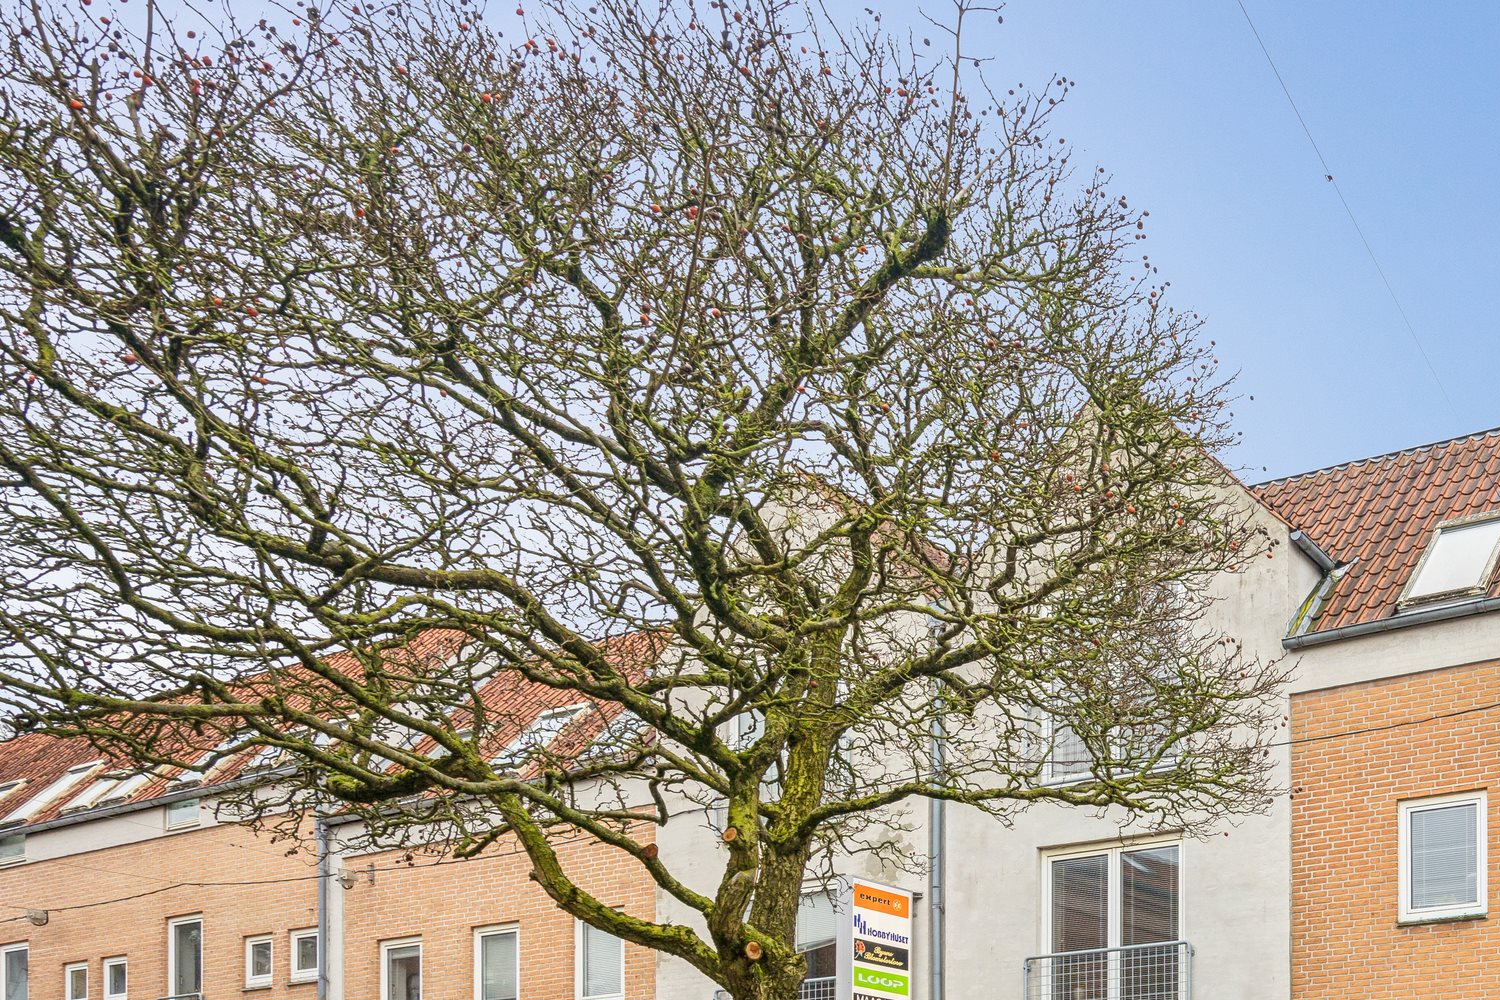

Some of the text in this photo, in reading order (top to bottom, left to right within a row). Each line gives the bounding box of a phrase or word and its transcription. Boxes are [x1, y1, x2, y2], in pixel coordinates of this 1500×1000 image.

[860, 893, 890, 906] expert
[867, 927, 909, 944] HOBBYHUSET
[858, 973, 904, 988] LOOP
